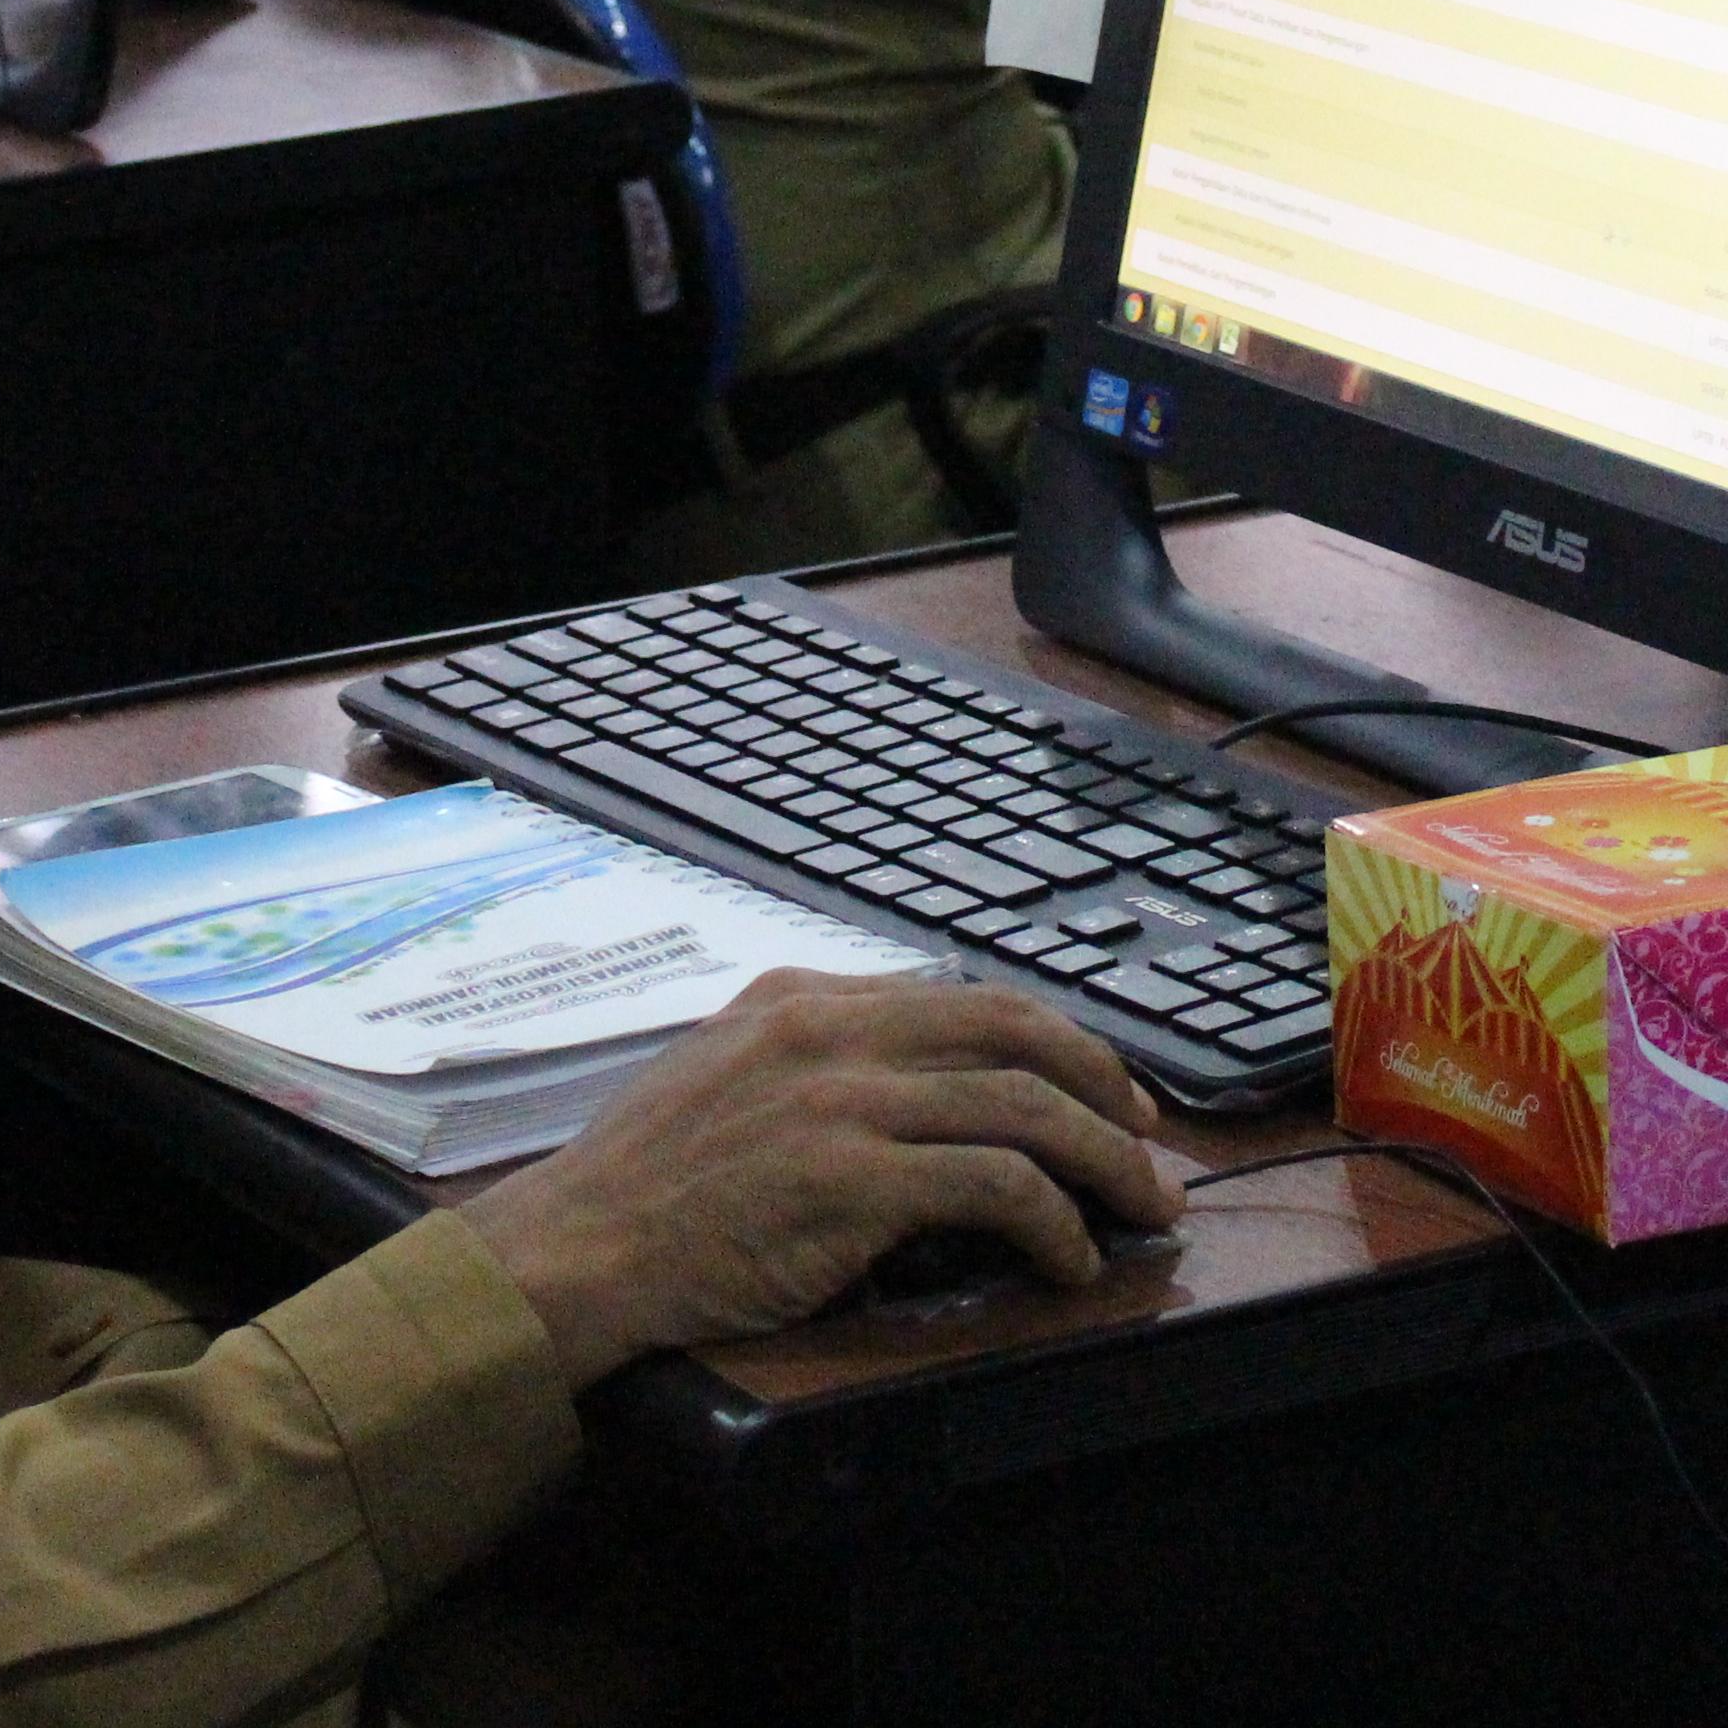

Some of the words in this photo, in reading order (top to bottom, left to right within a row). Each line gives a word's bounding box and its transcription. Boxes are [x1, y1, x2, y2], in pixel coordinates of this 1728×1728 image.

[1486, 509, 1589, 573] ASUS
[1125, 894, 1207, 928] ASUS
[587, 924, 692, 964] MELALUI
[495, 954, 587, 991] SIMPUL
[574, 943, 700, 991] INFORMASI
[362, 979, 494, 1024] JARINGAN
[422, 983, 564, 1027] GEOSPASIAL
[1379, 1040, 1452, 1090] Selamat
[1440, 1064, 1540, 1130] Menikmati
